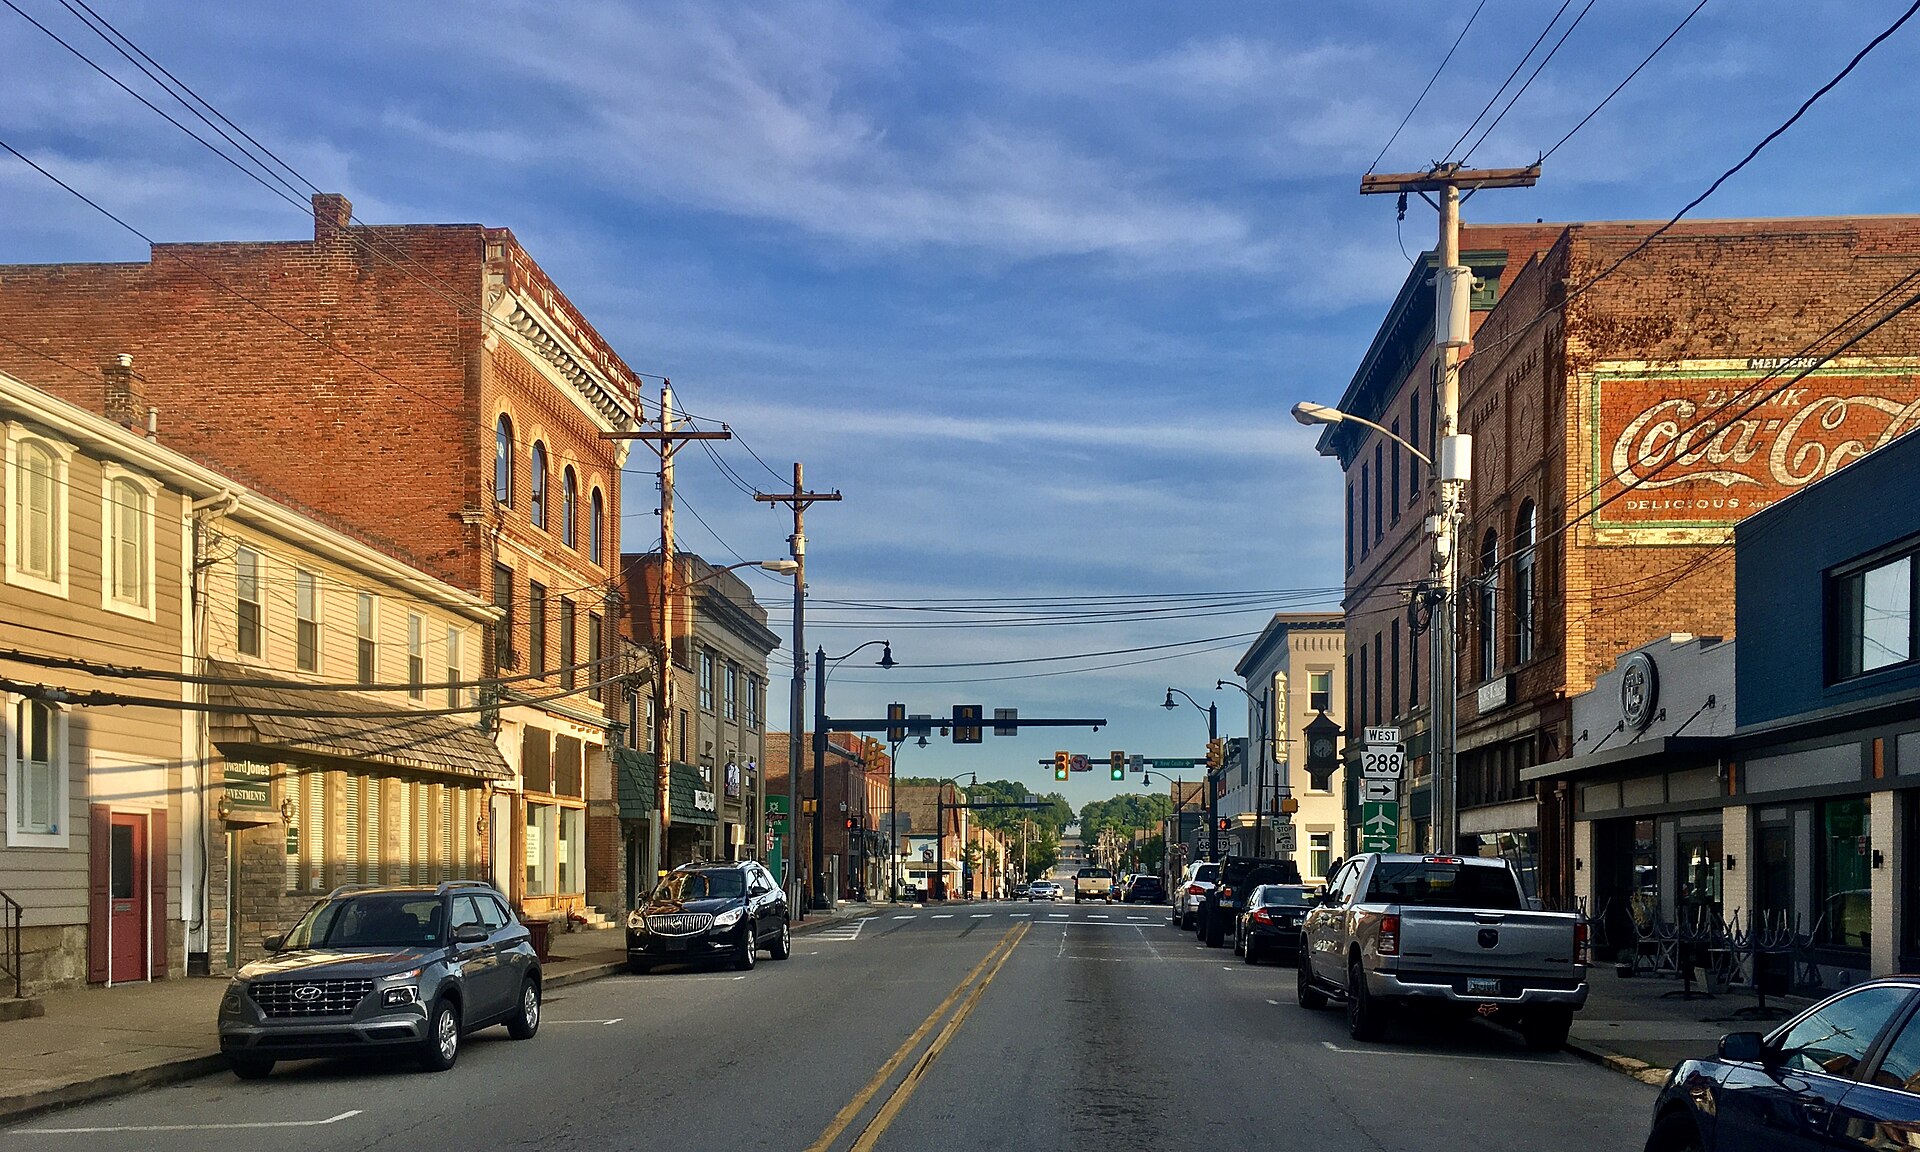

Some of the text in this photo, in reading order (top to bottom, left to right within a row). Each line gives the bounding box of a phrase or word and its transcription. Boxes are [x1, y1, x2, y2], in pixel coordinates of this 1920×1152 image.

[1703, 388, 1808, 408] DRINK
[1627, 498, 1739, 510] DELICIOUS
[1278, 681, 1287, 752] KAUFMAN
[1369, 729, 1396, 741] WEST
[1365, 753, 1399, 773] 288
[1200, 841, 1210, 850] 68
[1219, 841, 1227, 849] 19
